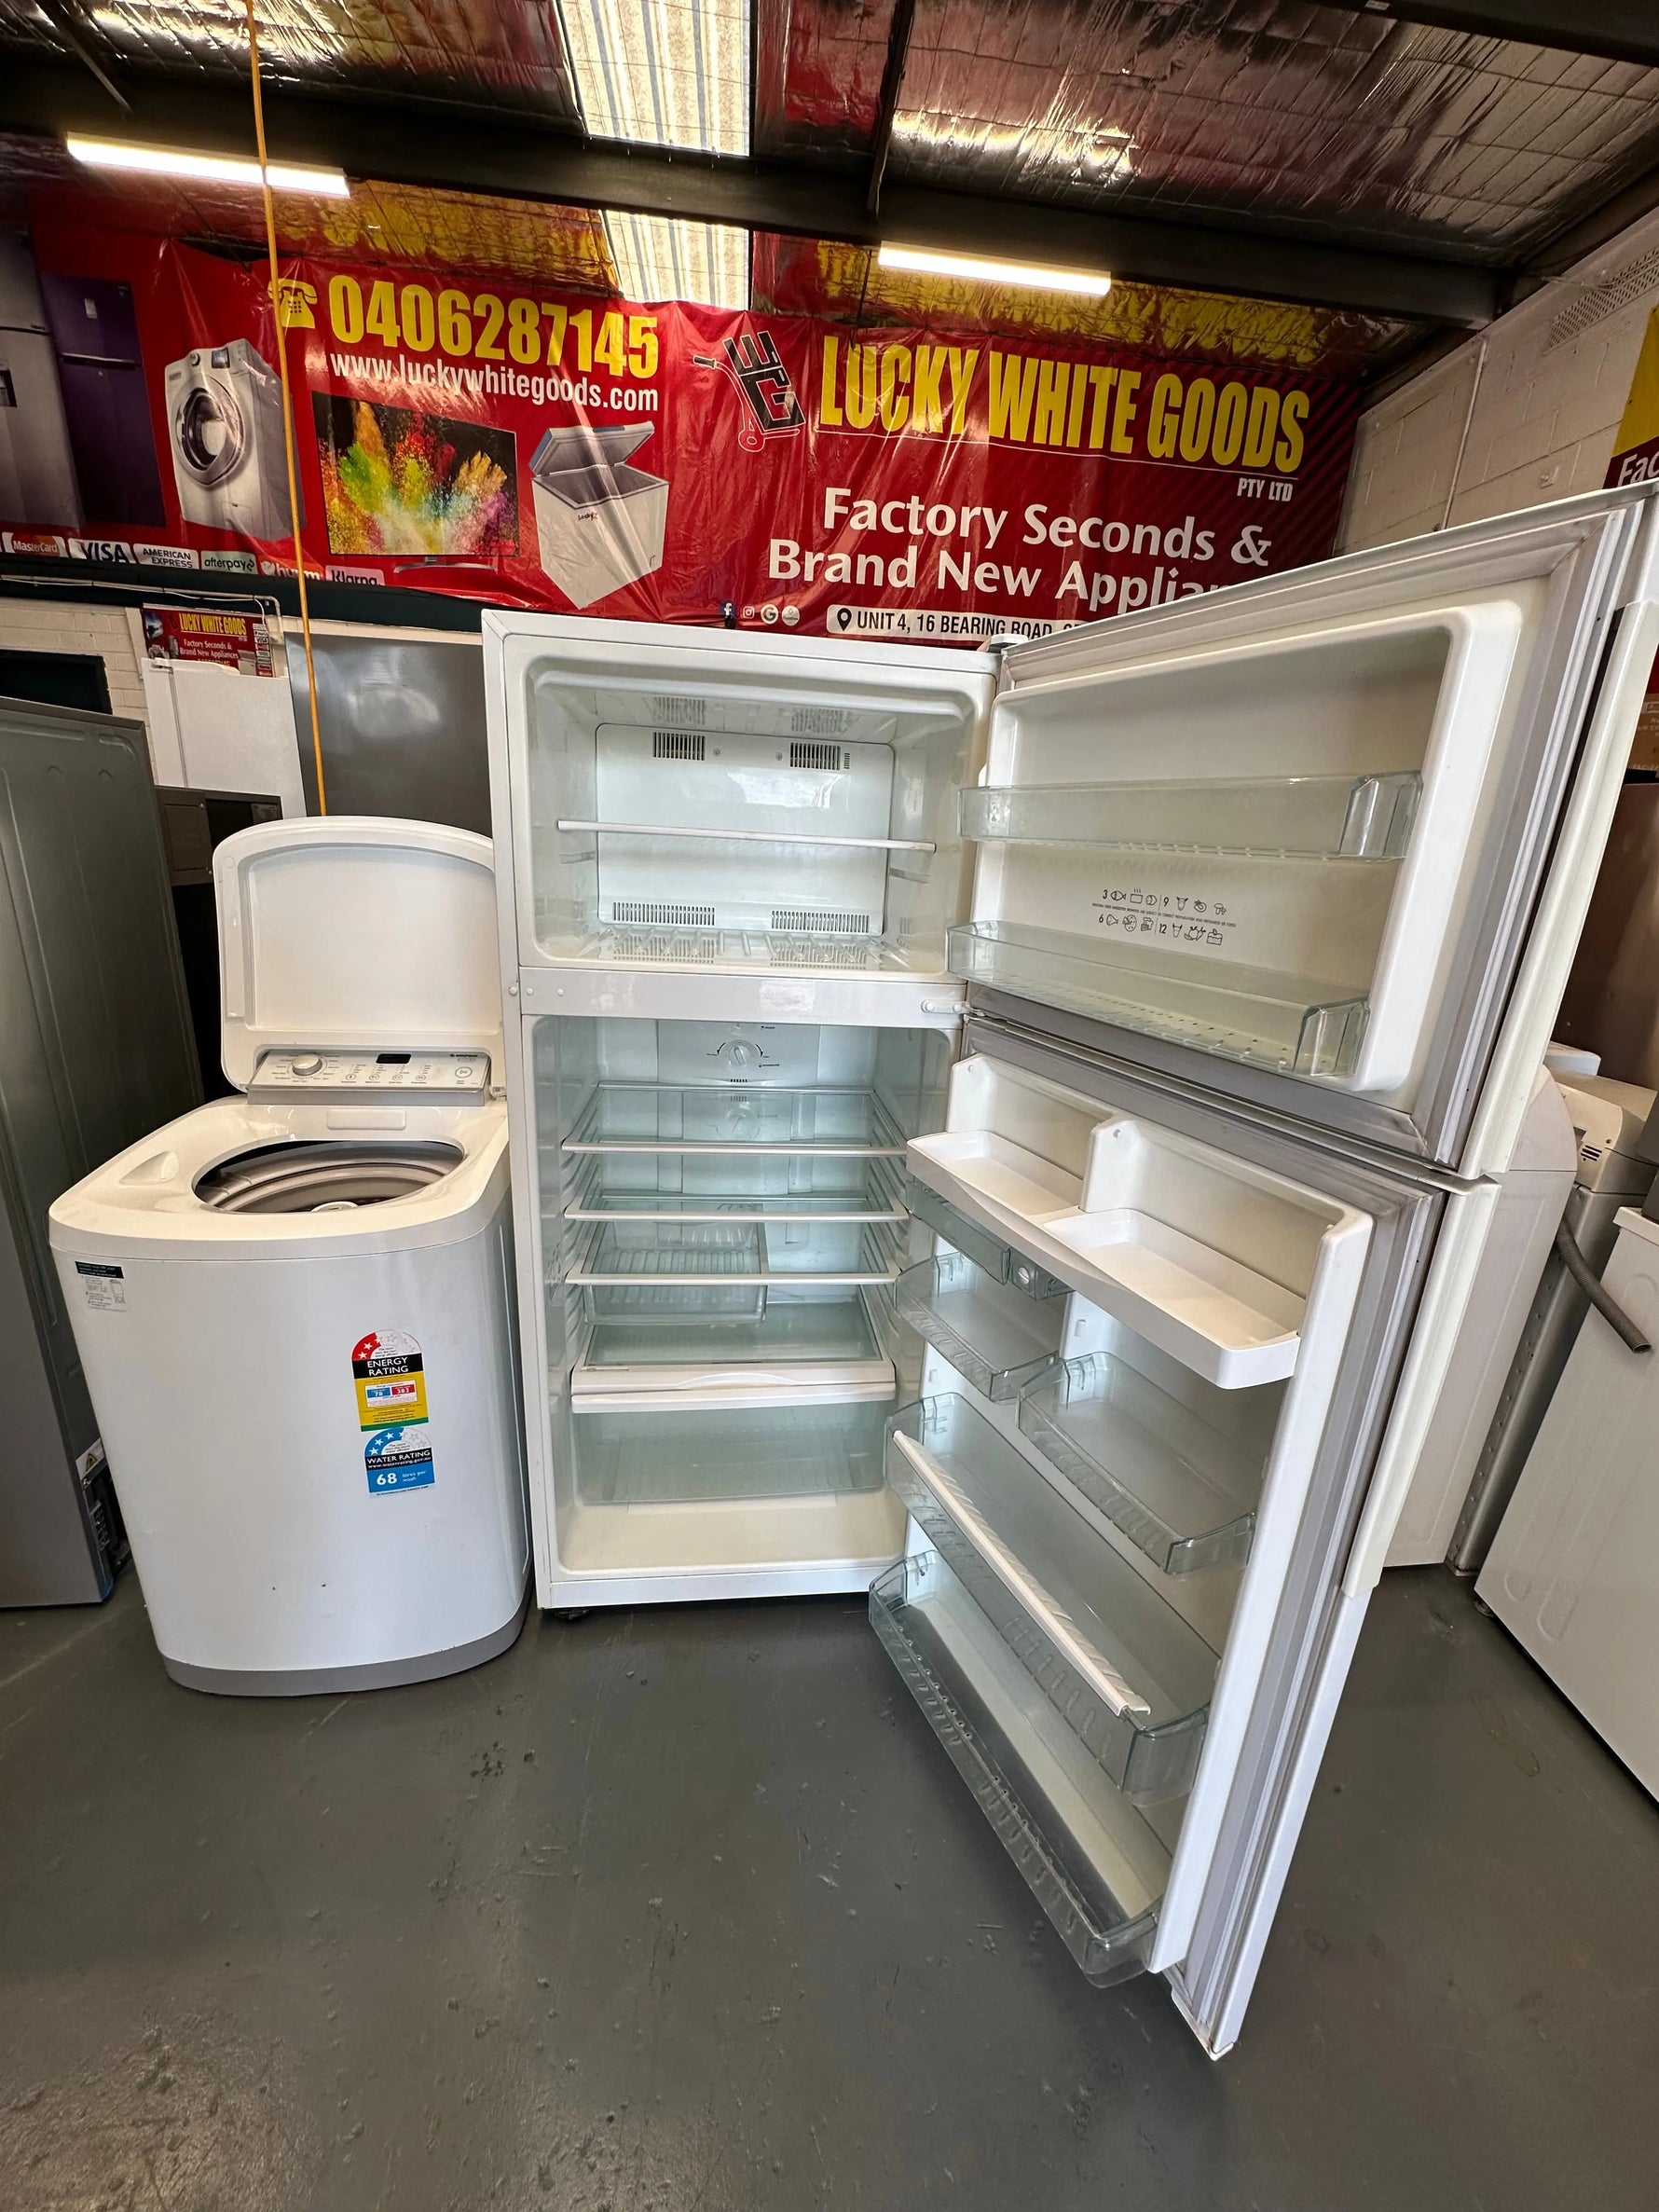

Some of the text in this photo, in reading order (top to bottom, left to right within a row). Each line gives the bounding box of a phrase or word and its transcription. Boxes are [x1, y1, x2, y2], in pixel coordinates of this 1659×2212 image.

[328, 274, 659, 379] 0406287145
[330, 352, 659, 412] www.luckywhitegoods.com
[820, 335, 1309, 473] LUCKY WHITE GOODS
[1237, 477, 1293, 503] PTY LTD
[824, 487, 1271, 567] Factory Seconds &
[13, 541, 58, 553] MasterCard
[76, 542, 128, 562] VISA
[143, 548, 192, 559] AMERICAN
[152, 556, 193, 569] EXPRESS
[204, 557, 248, 571] afterpay
[769, 538, 918, 589] Brand
[938, 552, 1042, 598] New
[179, 612, 200, 631] LUCKY
[200, 614, 224, 634] WHITE
[224, 616, 247, 636] GOODS
[857, 611, 895, 630] UNIT
[898, 613, 911, 634] 4,
[917, 613, 935, 633] 16
[940, 614, 1006, 636] BEARING
[184, 639, 203, 650] Factory
[1103, 889, 1169, 907] 3 9
[1099, 914, 1167, 934] 6 12
[367, 1356, 408, 1368] ENERGY
[369, 1366, 408, 1376] RATING
[367, 1450, 431, 1464] WATER RATING
[377, 1473, 398, 1486] 68
